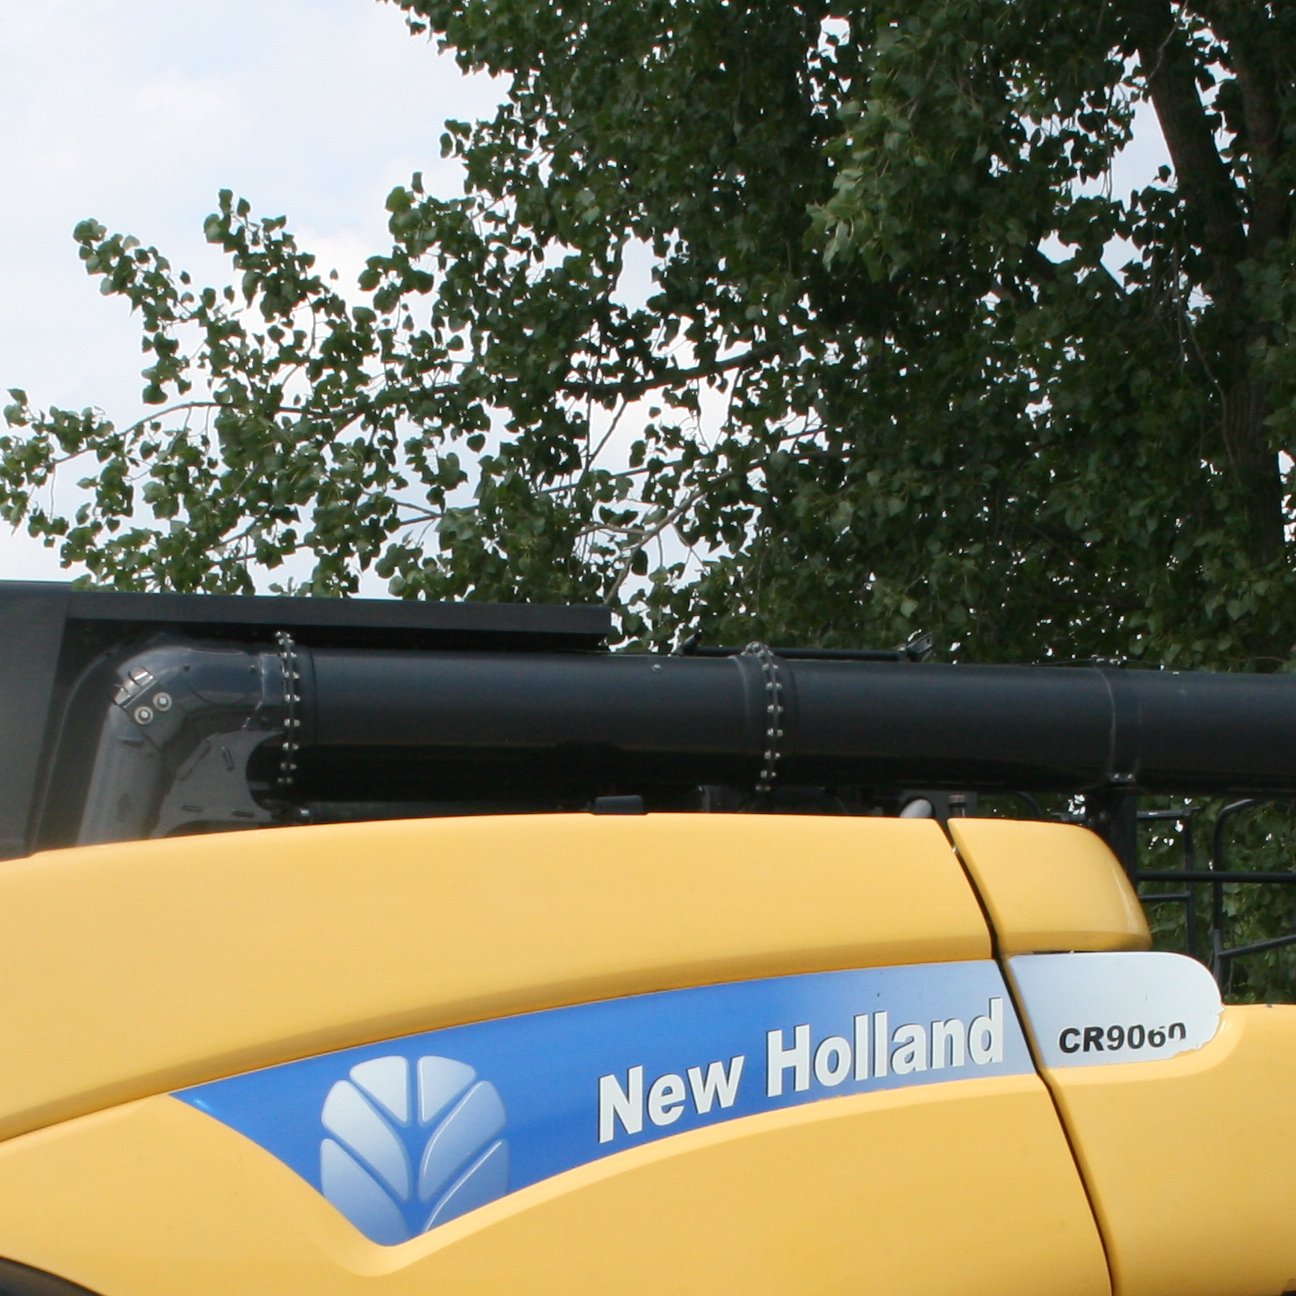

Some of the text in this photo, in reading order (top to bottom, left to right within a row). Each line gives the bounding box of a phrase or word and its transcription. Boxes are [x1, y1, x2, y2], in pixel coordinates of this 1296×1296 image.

[598, 997, 1003, 1143] New Holland
[1059, 1022, 1187, 1053] CR9060
